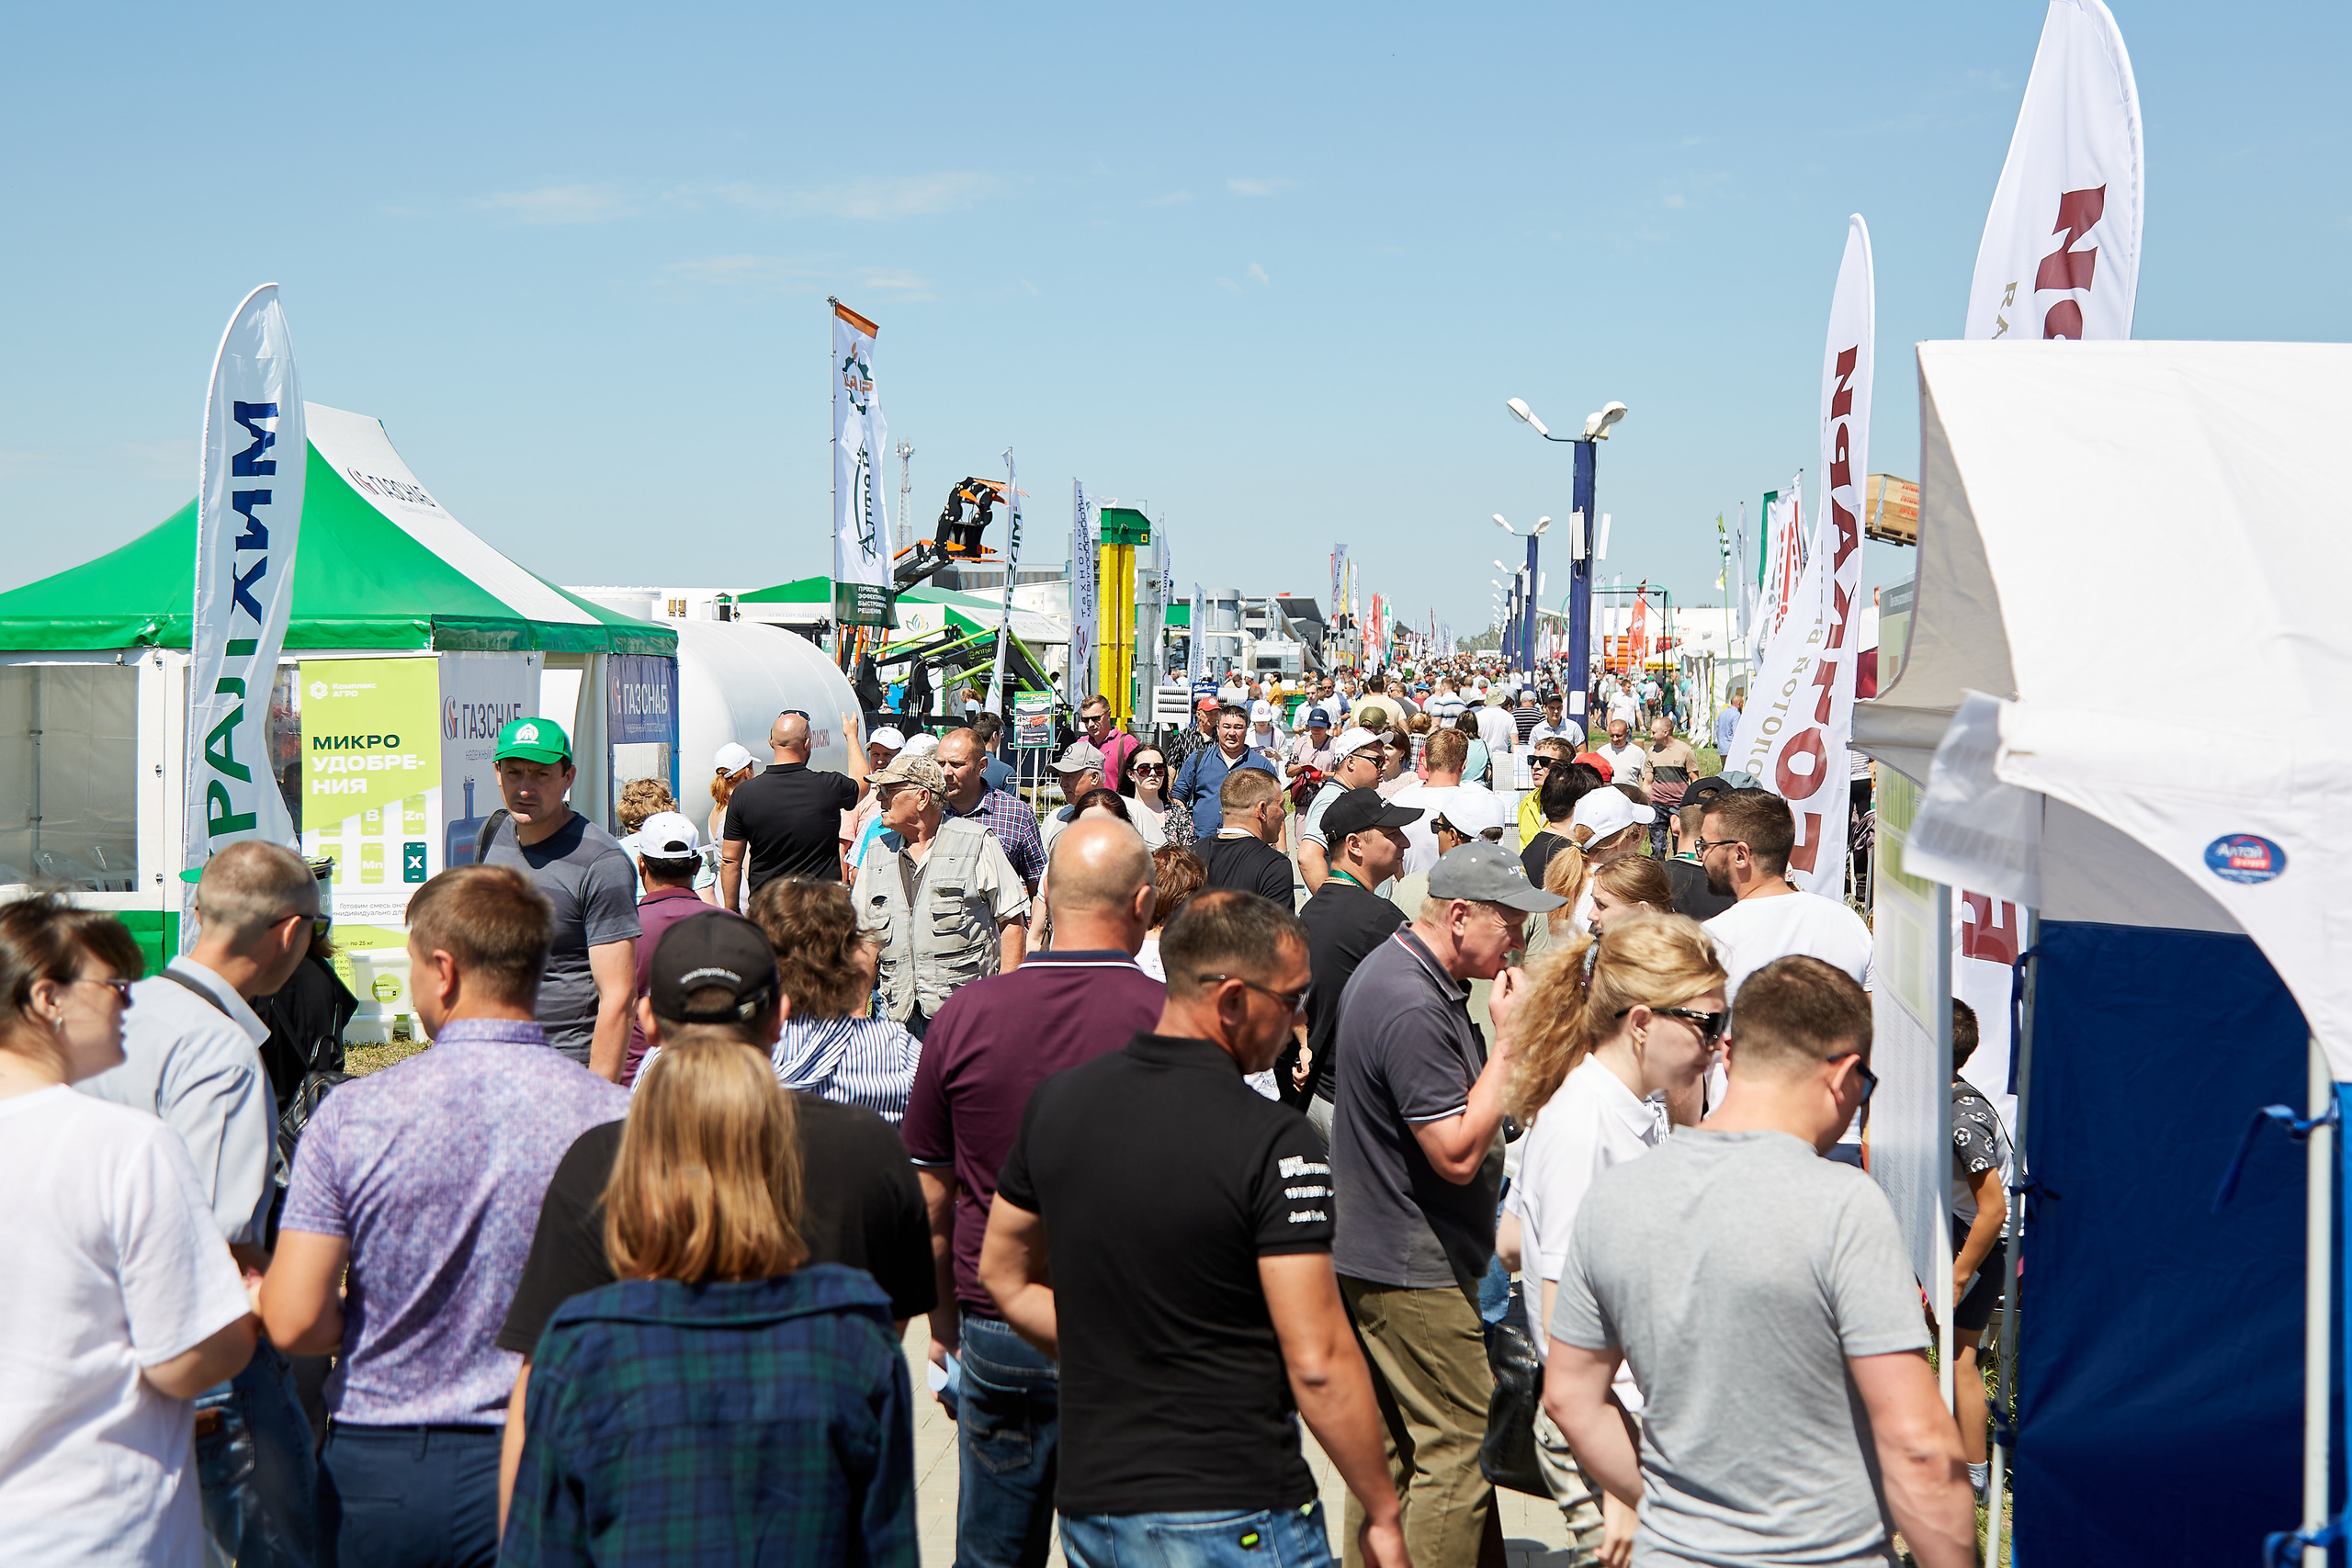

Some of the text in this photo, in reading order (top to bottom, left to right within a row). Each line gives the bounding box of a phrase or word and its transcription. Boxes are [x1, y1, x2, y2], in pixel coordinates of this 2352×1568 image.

[204, 400, 279, 851] РАЛХИМ
[624, 683, 668, 715] ГАЗСНАБ
[312, 734, 401, 750] МИКРО
[311, 754, 425, 774] УДОБРЕ-
[312, 779, 368, 795] НИЯ
[404, 810, 424, 821] Zn
[362, 860, 383, 870] Mn
